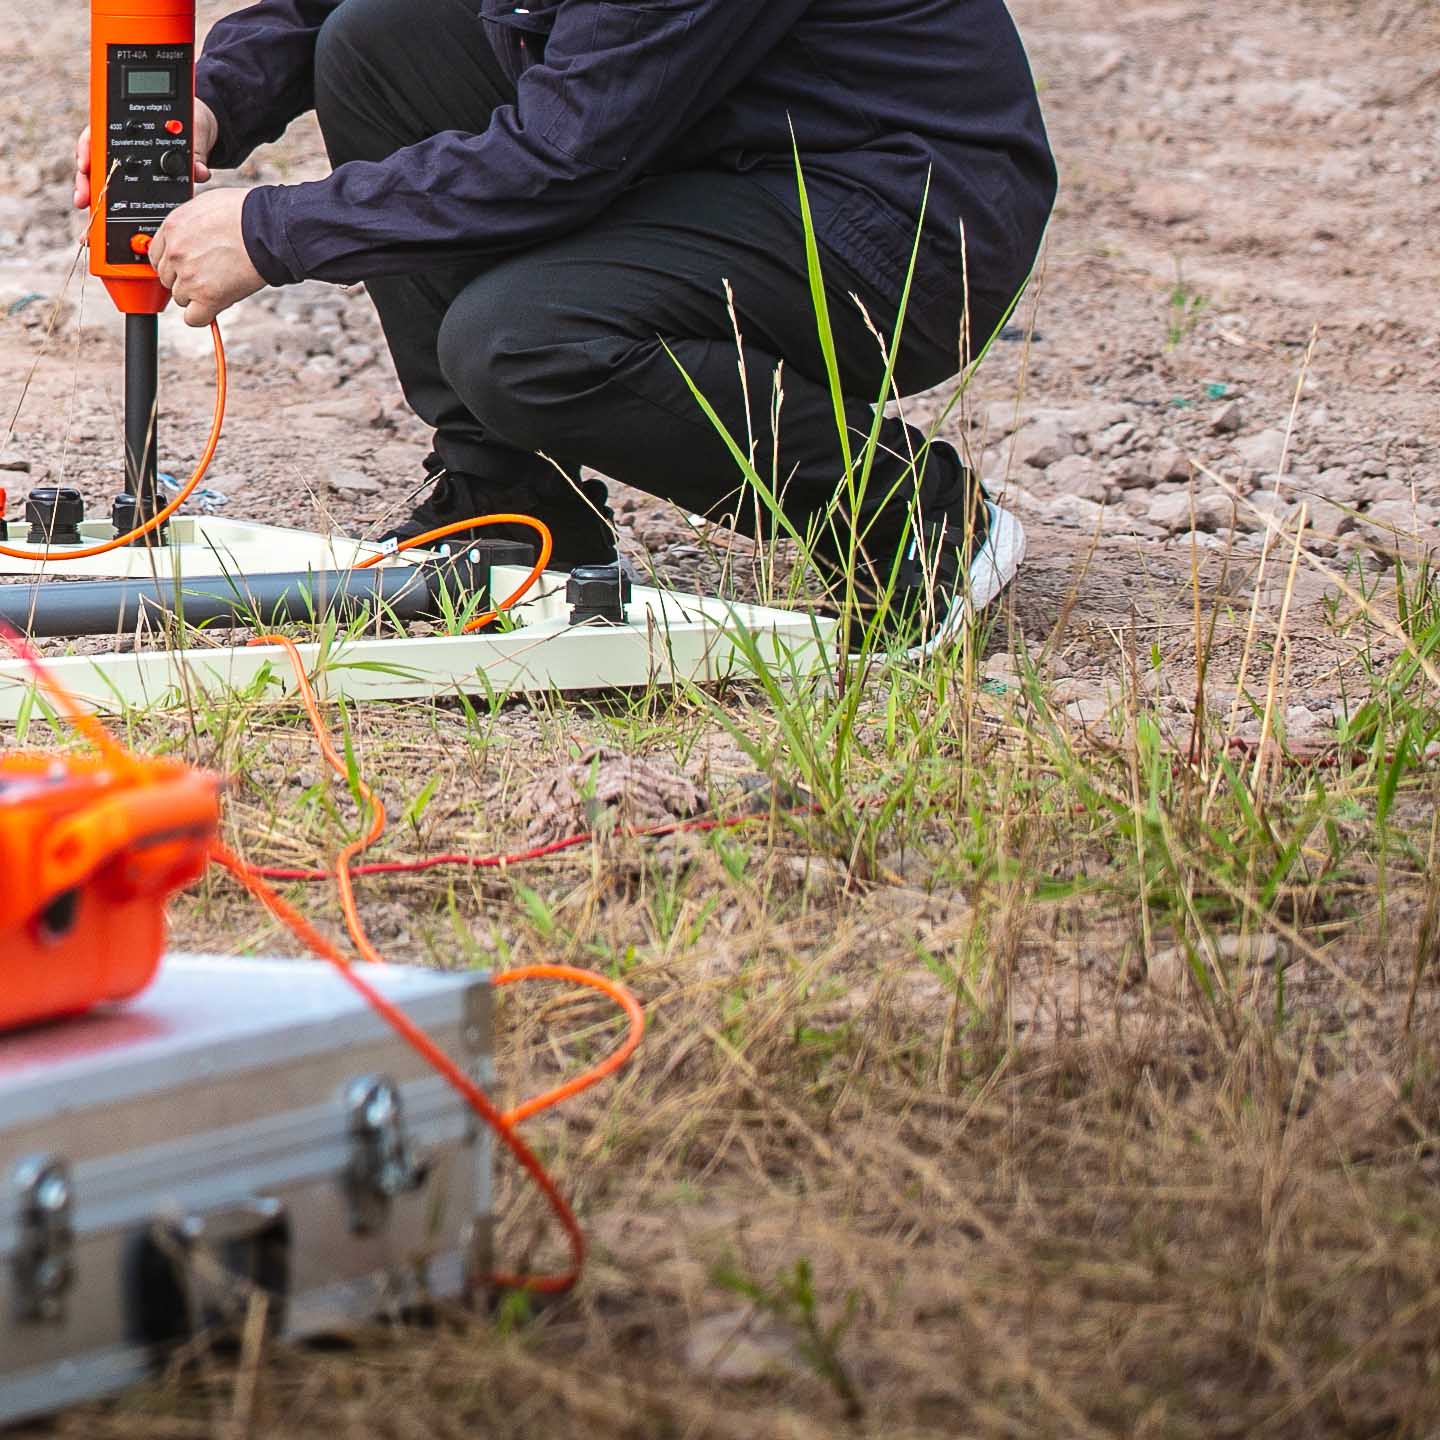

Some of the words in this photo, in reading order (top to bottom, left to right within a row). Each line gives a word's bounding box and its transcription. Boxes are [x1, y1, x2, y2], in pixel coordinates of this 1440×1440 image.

[156, 50, 184, 60] Adapter
[129, 103, 145, 112] Battery
[146, 103, 162, 112] voltage
